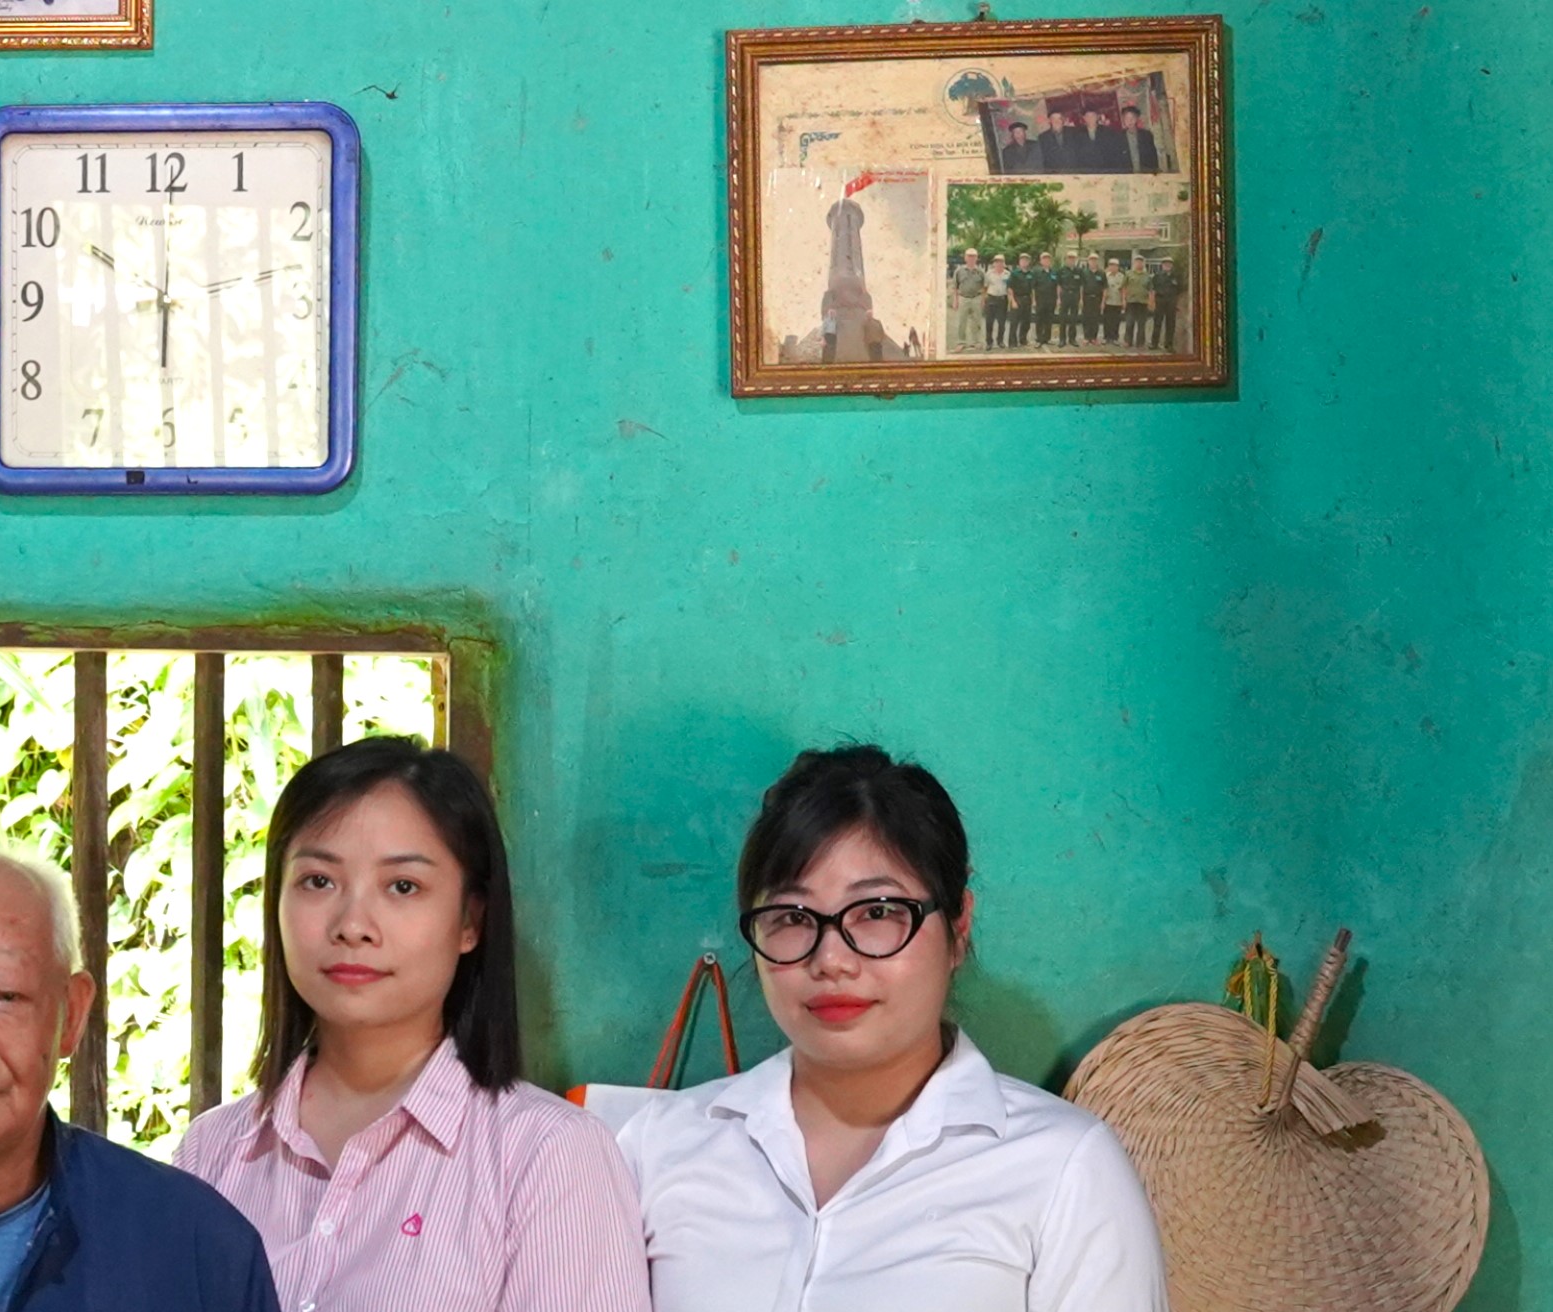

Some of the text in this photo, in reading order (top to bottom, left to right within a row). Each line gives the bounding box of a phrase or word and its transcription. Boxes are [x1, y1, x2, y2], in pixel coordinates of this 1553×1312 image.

[76, 153, 111, 193] 11
[145, 152, 188, 193] 12
[232, 152, 249, 192] 1
[20, 207, 60, 248] 10
[289, 201, 313, 242] 2
[20, 281, 44, 322] 9
[20, 360, 43, 401] 8
[81, 409, 105, 448] 7
[155, 407, 176, 447] 6
